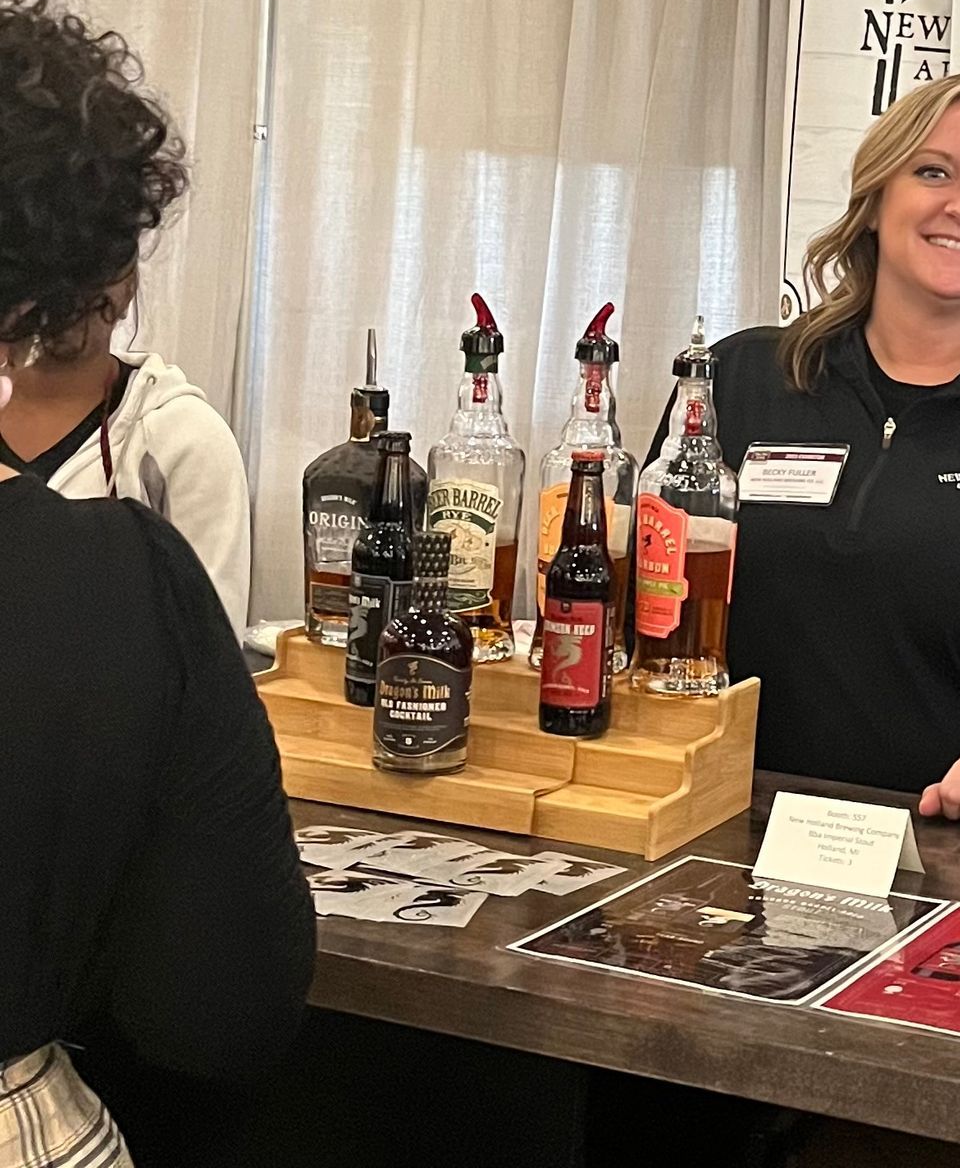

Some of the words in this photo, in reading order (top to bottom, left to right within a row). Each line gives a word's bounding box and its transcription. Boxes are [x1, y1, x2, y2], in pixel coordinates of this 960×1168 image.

[860, 8, 952, 55] NEW
[452, 487, 502, 519] BARREL
[442, 511, 472, 522] RYE
[422, 684, 451, 700] Milk
[395, 700, 448, 712] FASHIONED
[389, 709, 434, 722] COCKTAIL
[789, 815, 805, 824] New
[806, 818, 834, 830] Holland
[835, 822, 865, 836] Brewing
[866, 827, 900, 840] Company
[839, 896, 894, 913] Milk
